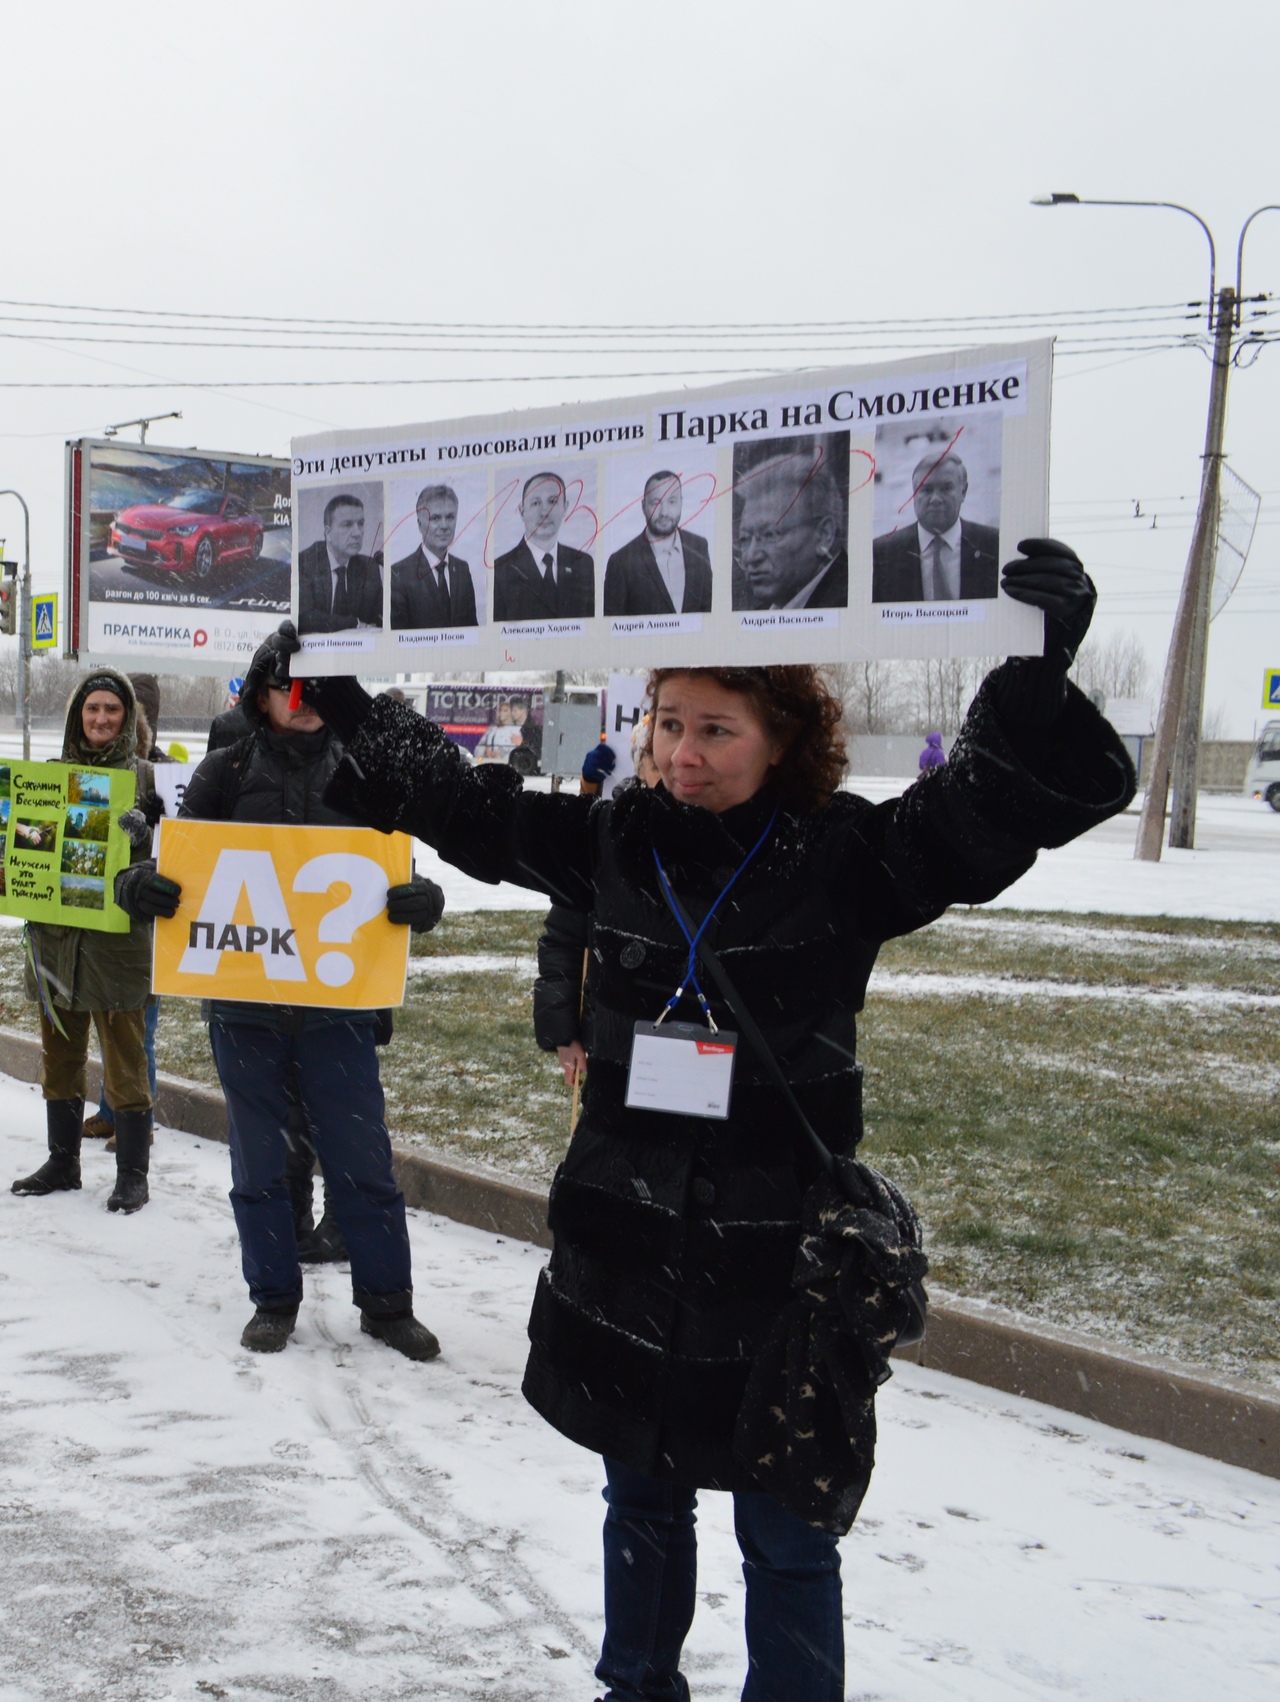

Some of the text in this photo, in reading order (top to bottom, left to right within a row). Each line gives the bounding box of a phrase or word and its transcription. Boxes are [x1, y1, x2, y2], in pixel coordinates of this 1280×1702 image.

[293, 375, 1020, 477] Эти депутаты голосовали против Парка на Смоленке
[105, 590, 132, 599] разгон
[133, 592, 144, 600] до
[146, 591, 160, 600] 100
[881, 606, 969, 619] Игорь Высоцкий
[612, 620, 680, 632] Андрей Анохин
[741, 614, 824, 627] Андрей Васильев
[103, 623, 191, 640] ПРАГМАТИКА
[501, 624, 581, 636] Александр Ходосок
[302, 639, 363, 649] Сергей Никешин
[398, 633, 465, 644] Владимир Носов
[189, 921, 296, 956] ПАРК
